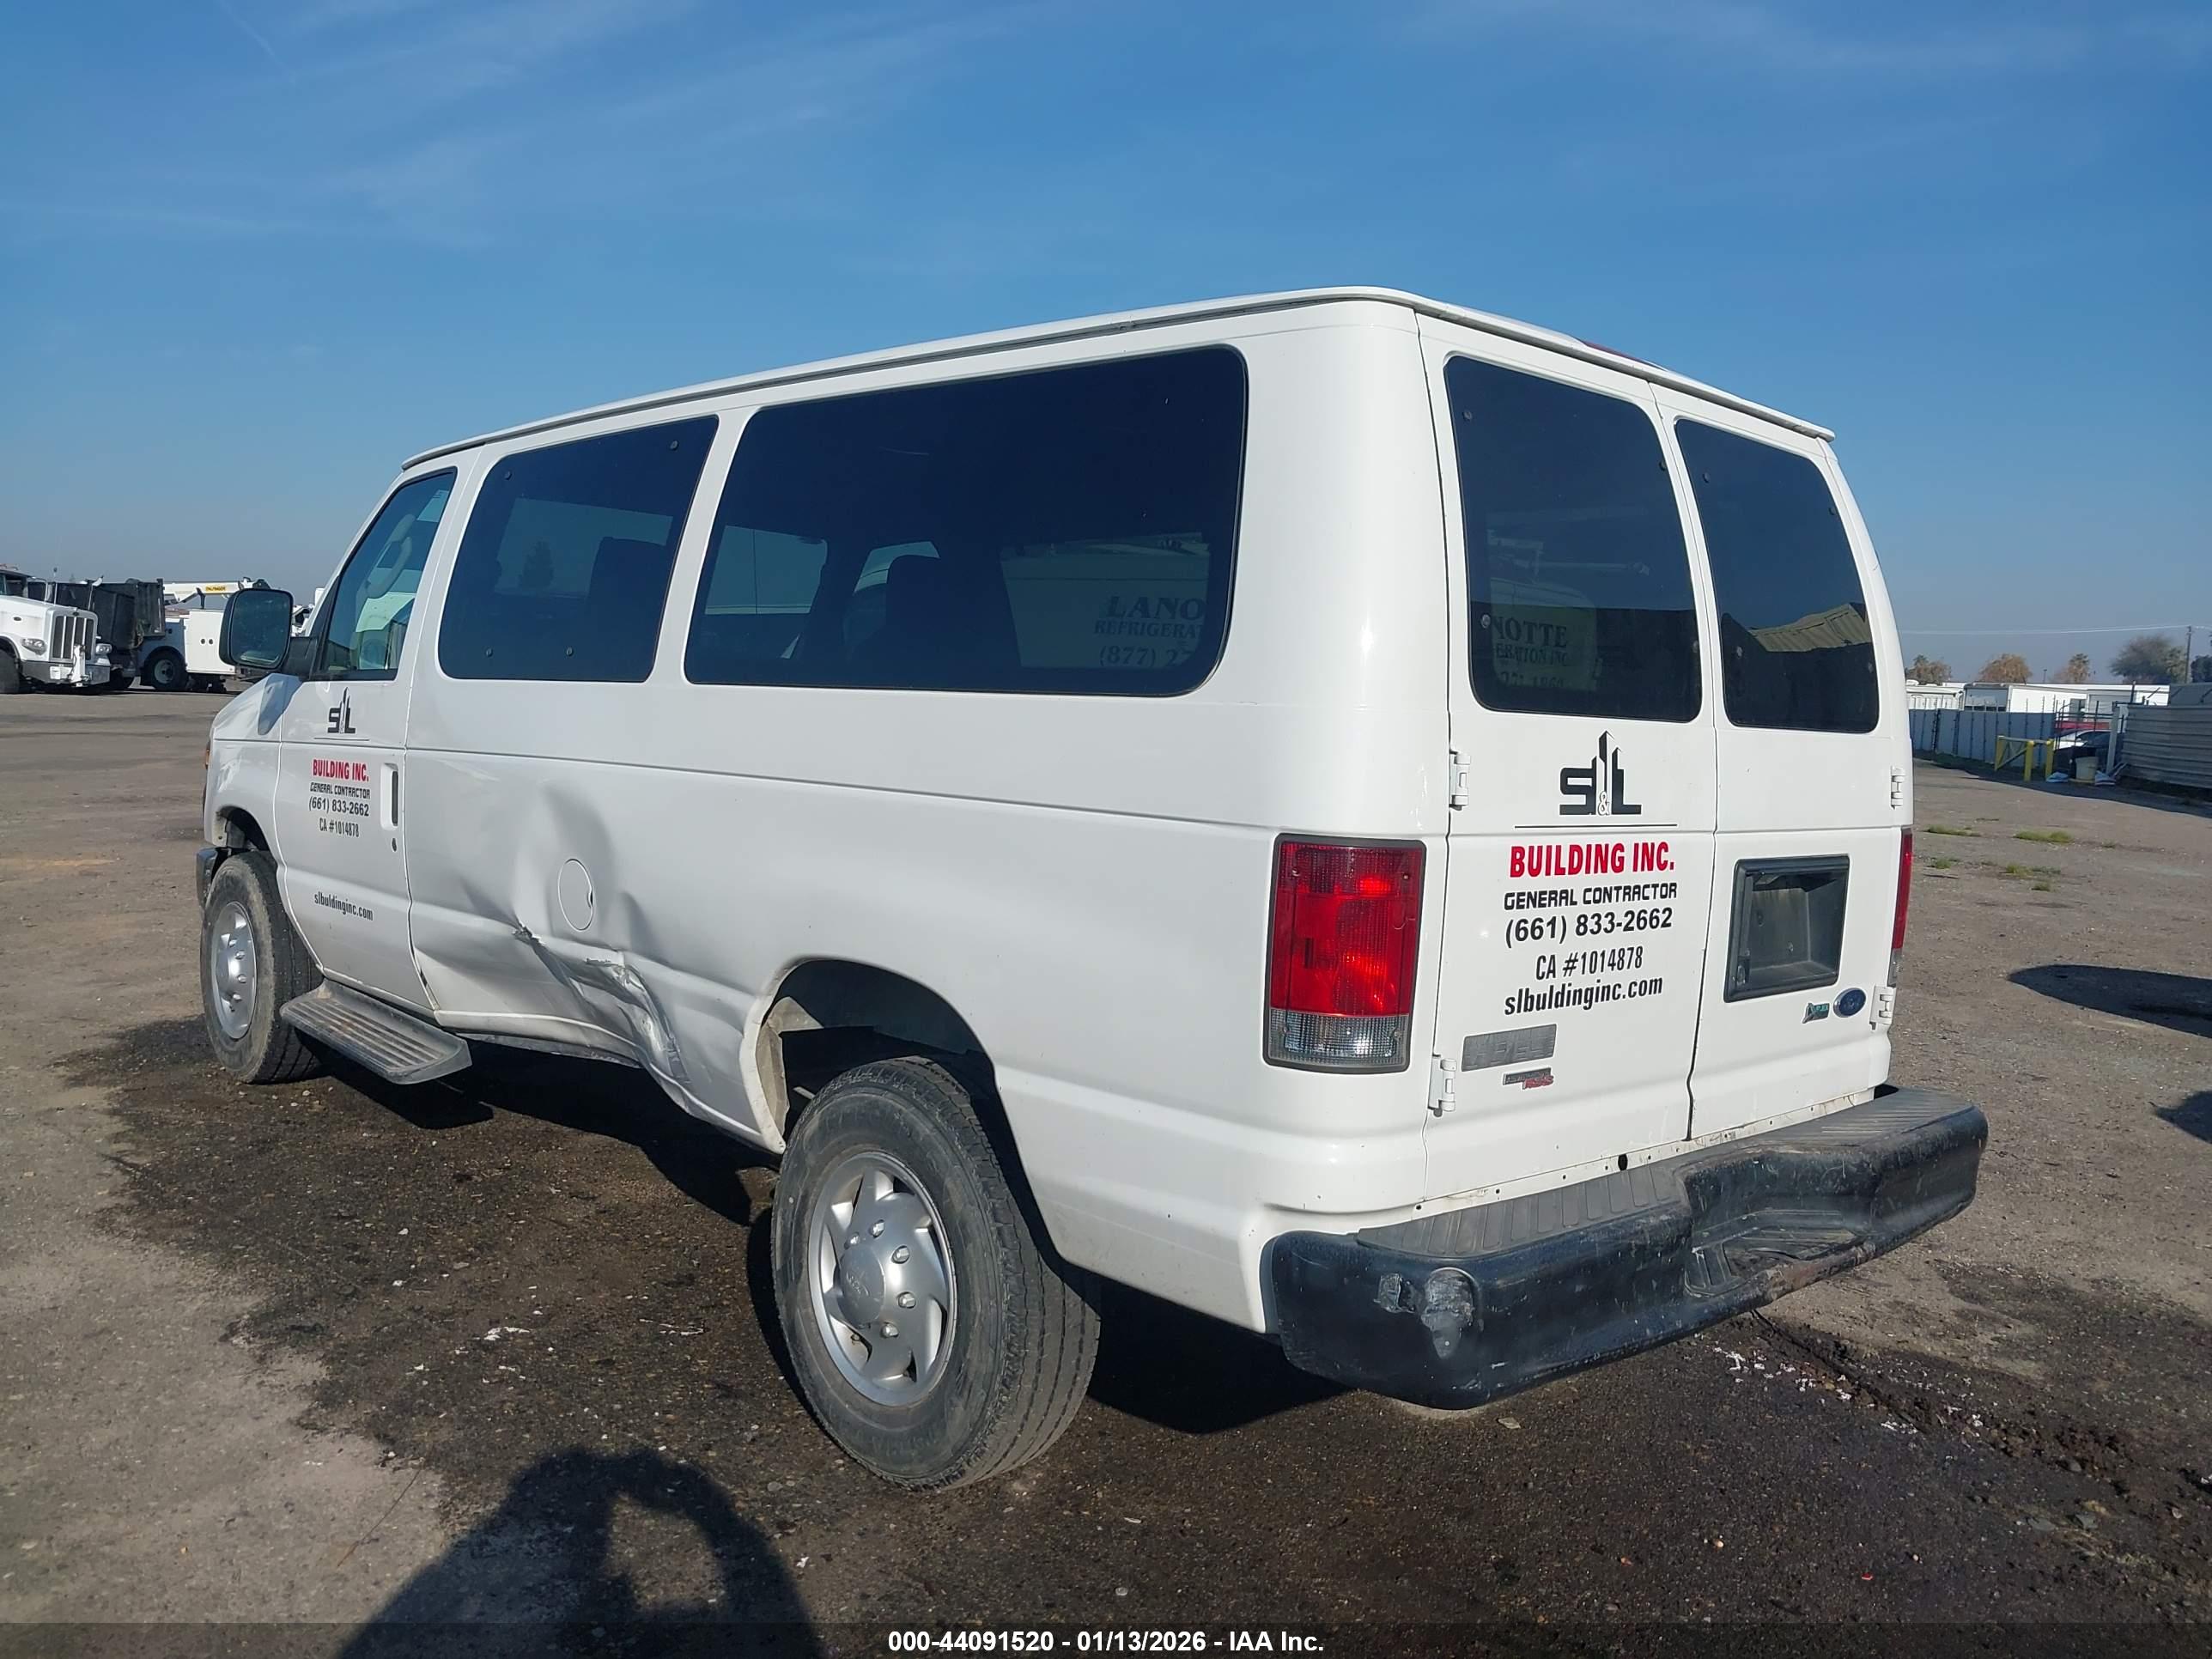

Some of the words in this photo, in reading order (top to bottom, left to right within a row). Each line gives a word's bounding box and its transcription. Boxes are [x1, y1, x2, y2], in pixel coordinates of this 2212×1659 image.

[313, 759, 349, 780] BUILDING
[352, 763, 369, 781] INC.
[310, 782, 333, 794] GENERAL
[334, 785, 371, 799] CONTRACTOR
[309, 796, 330, 813] (661)
[332, 799, 369, 817] 833-2662
[319, 817, 328, 831] CA
[329, 819, 360, 837] #1014878
[1510, 842, 1626, 878] BUILDING
[1632, 842, 1674, 872] INC.
[314, 890, 374, 921] slbuldinginc.com
[1504, 889, 1577, 910] GENERAL
[1583, 883, 1677, 904] CONTRACTOR
[1505, 915, 1567, 948] (661)
[1575, 907, 1673, 937] 833-2662
[1535, 954, 1556, 980] CA
[1562, 945, 1644, 977] #1014878
[1504, 977, 1663, 1015] slbuldinginc.com
